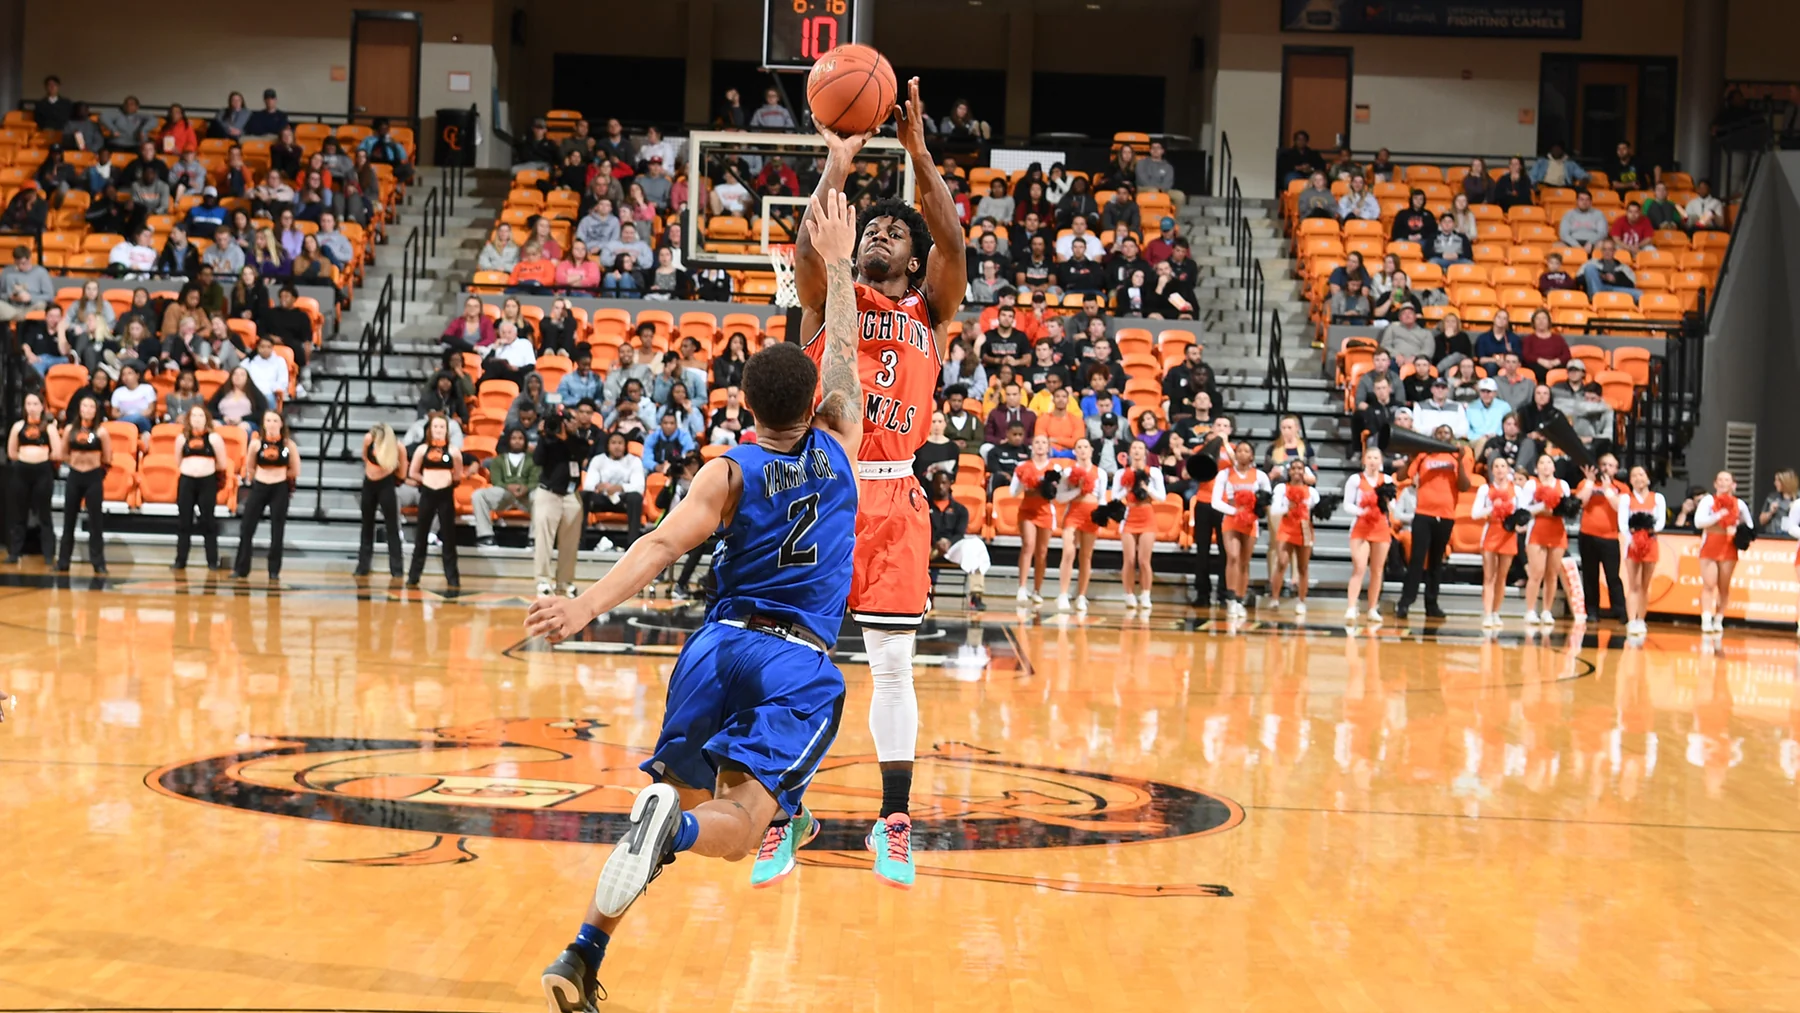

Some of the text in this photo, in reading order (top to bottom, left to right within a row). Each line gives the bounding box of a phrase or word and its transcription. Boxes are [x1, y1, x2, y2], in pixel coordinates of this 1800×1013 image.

[801, 16, 838, 60] 10
[1447, 15, 1566, 29] FIGHTING CAMELS
[875, 349, 899, 388] 3
[777, 492, 820, 568] 2
